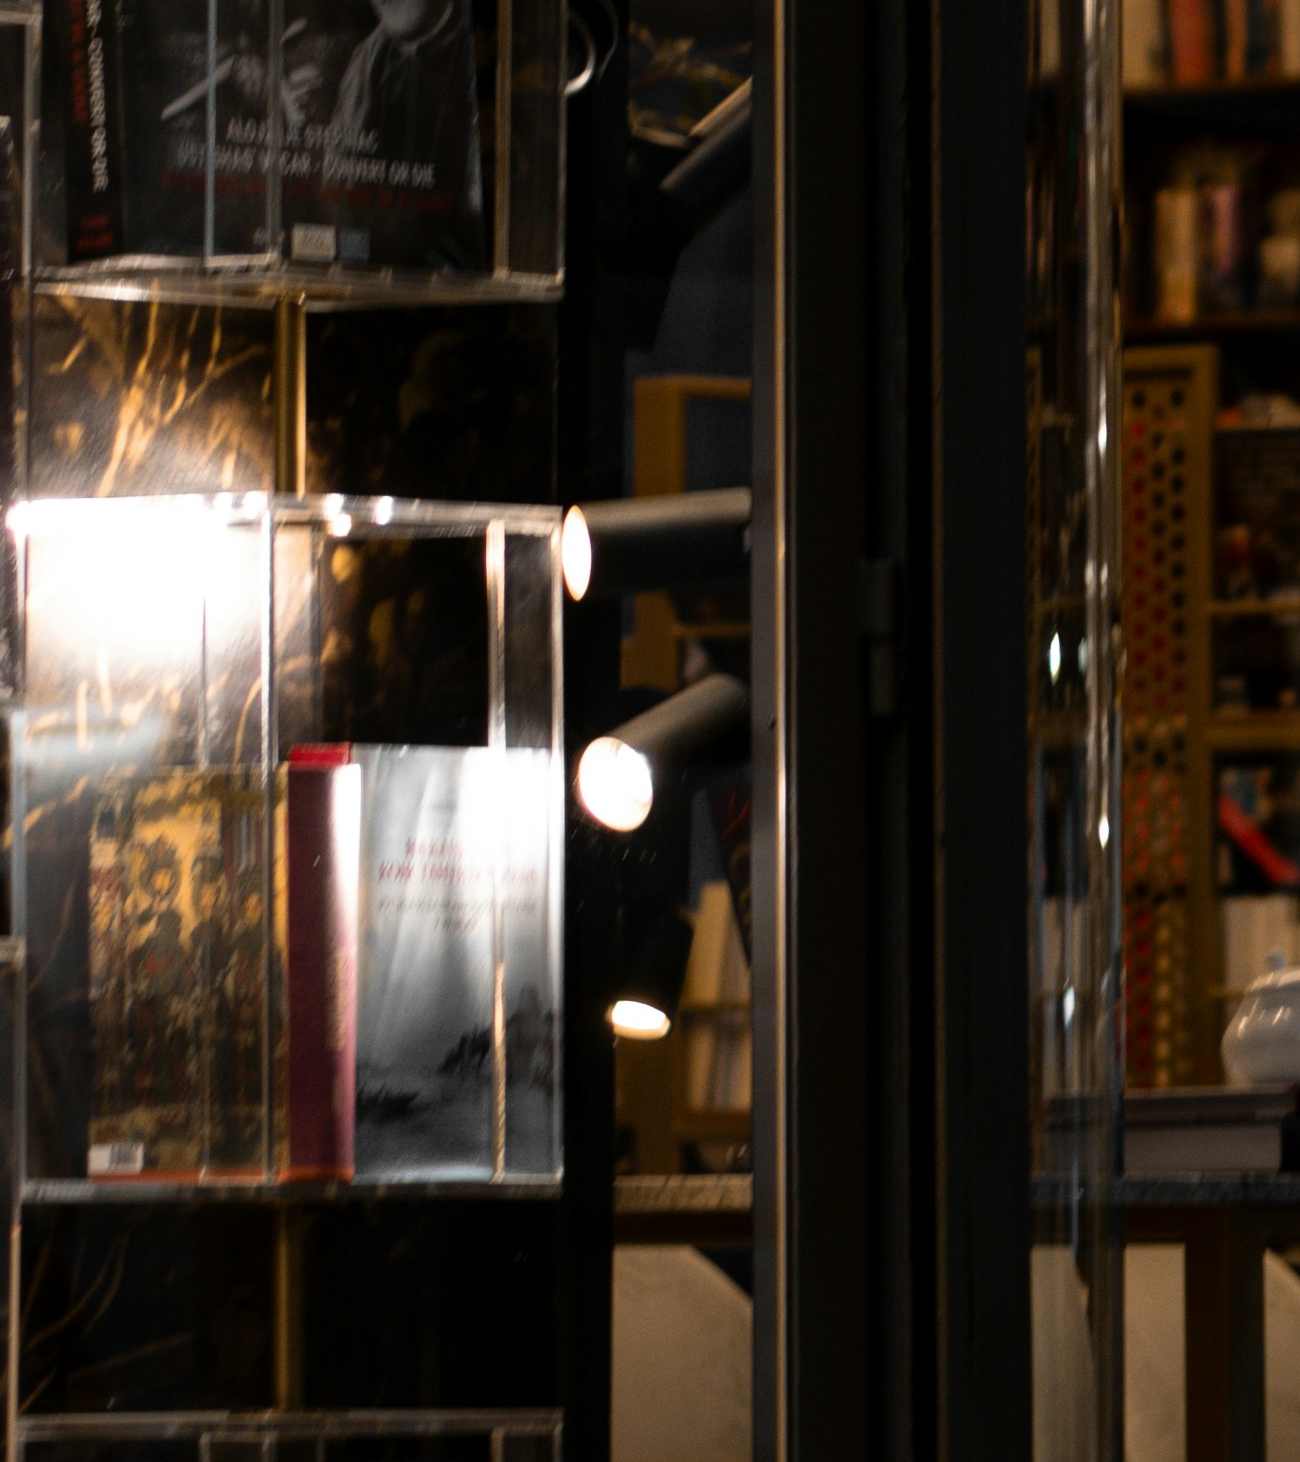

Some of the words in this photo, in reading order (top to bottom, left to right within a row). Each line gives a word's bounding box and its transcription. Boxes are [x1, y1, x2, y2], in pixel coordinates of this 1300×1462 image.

[88, 39, 106, 126] CONVERT
[91, 129, 107, 157] OR
[92, 160, 108, 190] DIE
